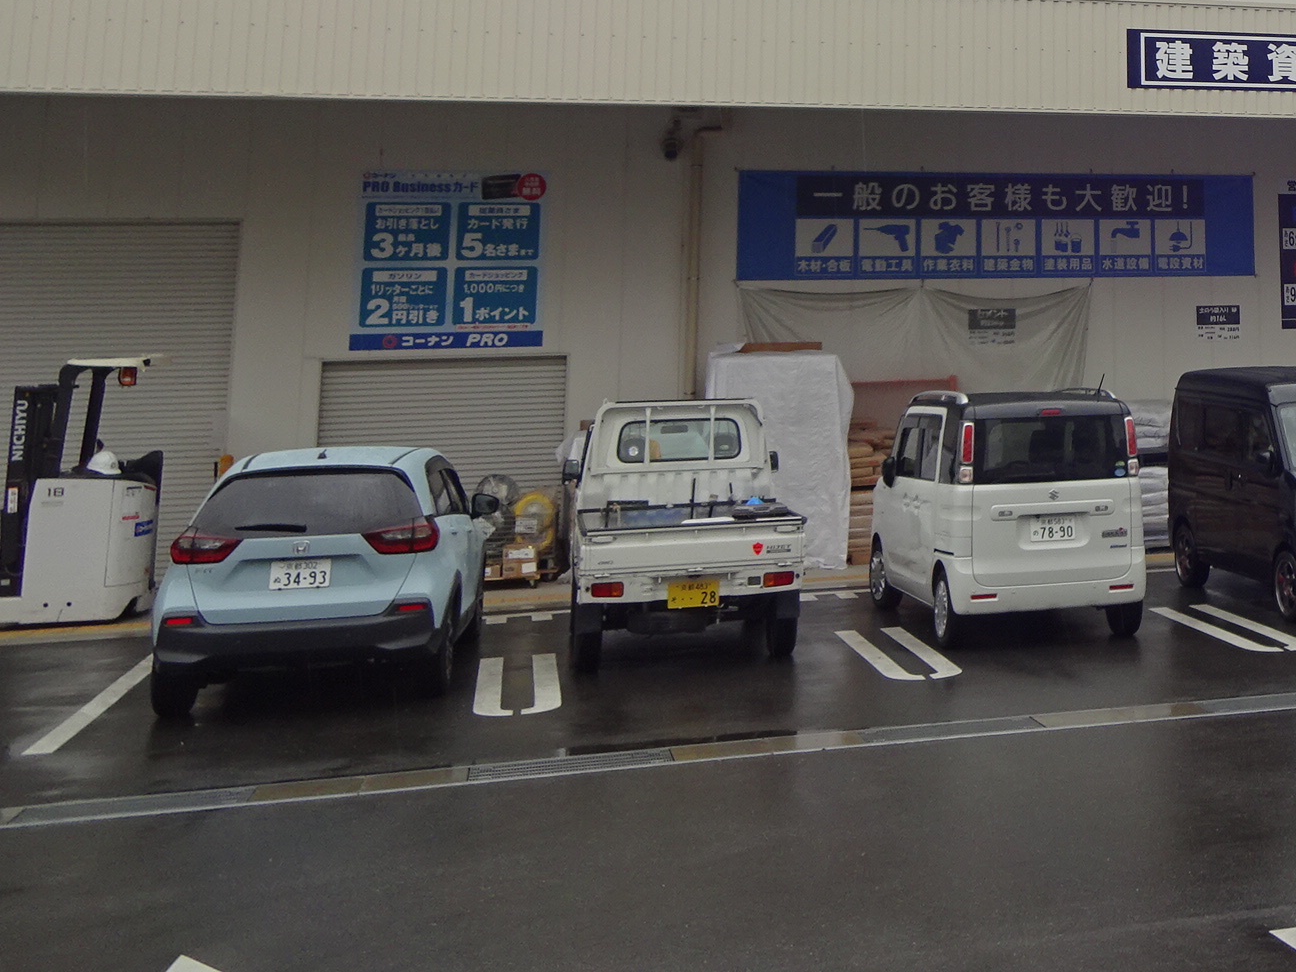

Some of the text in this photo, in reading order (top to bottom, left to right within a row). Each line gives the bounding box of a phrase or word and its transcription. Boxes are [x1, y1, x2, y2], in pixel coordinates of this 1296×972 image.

[467, 219, 528, 230] カード発行
[861, 259, 913, 272] 電動工具
[923, 259, 974, 272] 作業衣料
[984, 258, 1034, 271] 建築金物
[1044, 258, 1093, 271] 塗装用品
[1102, 258, 1149, 270] 水道設備
[1158, 257, 1204, 270] 電設資材
[402, 333, 508, 347] コーナン PRO
[11, 400, 29, 462] NICHIYU
[1040, 525, 1073, 539] 78-90
[283, 571, 327, 586] 34-93
